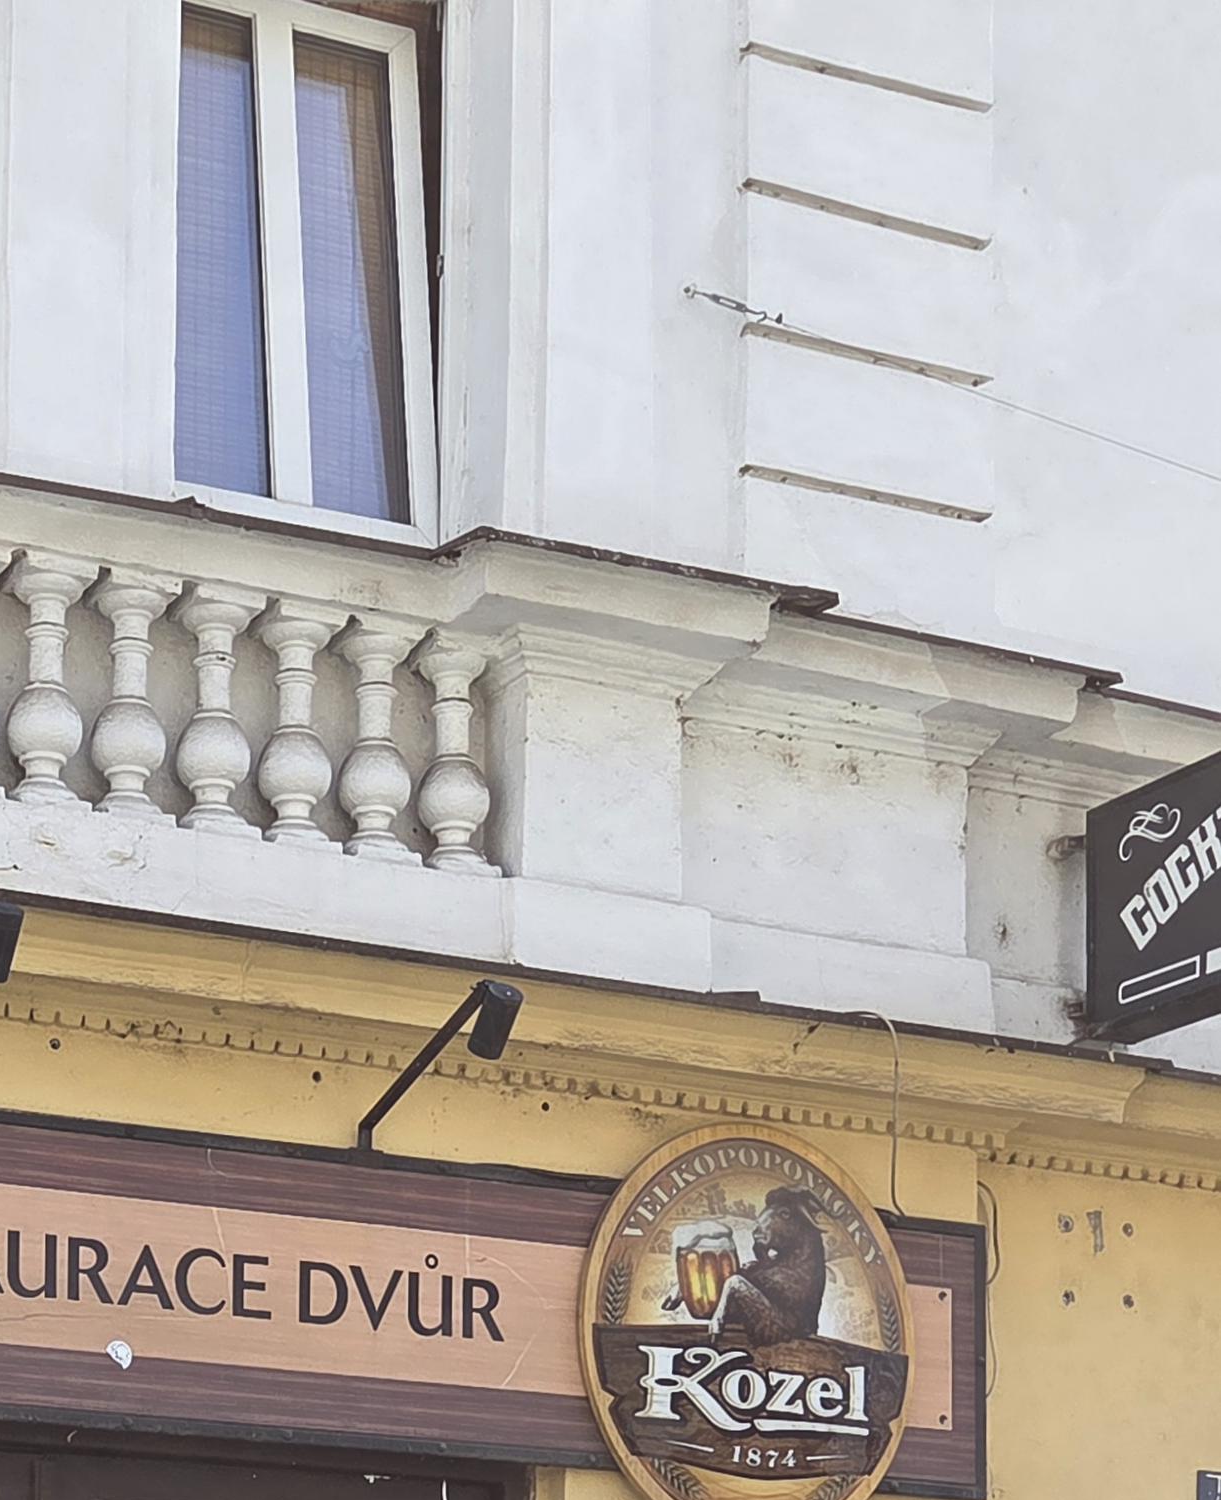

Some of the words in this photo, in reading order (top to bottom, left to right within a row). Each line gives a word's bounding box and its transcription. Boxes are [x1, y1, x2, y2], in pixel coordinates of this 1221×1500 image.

[298, 1252, 506, 1344] DVŮR
[634, 1344, 870, 1434] Kozel
[730, 1444, 798, 1469] 1874
